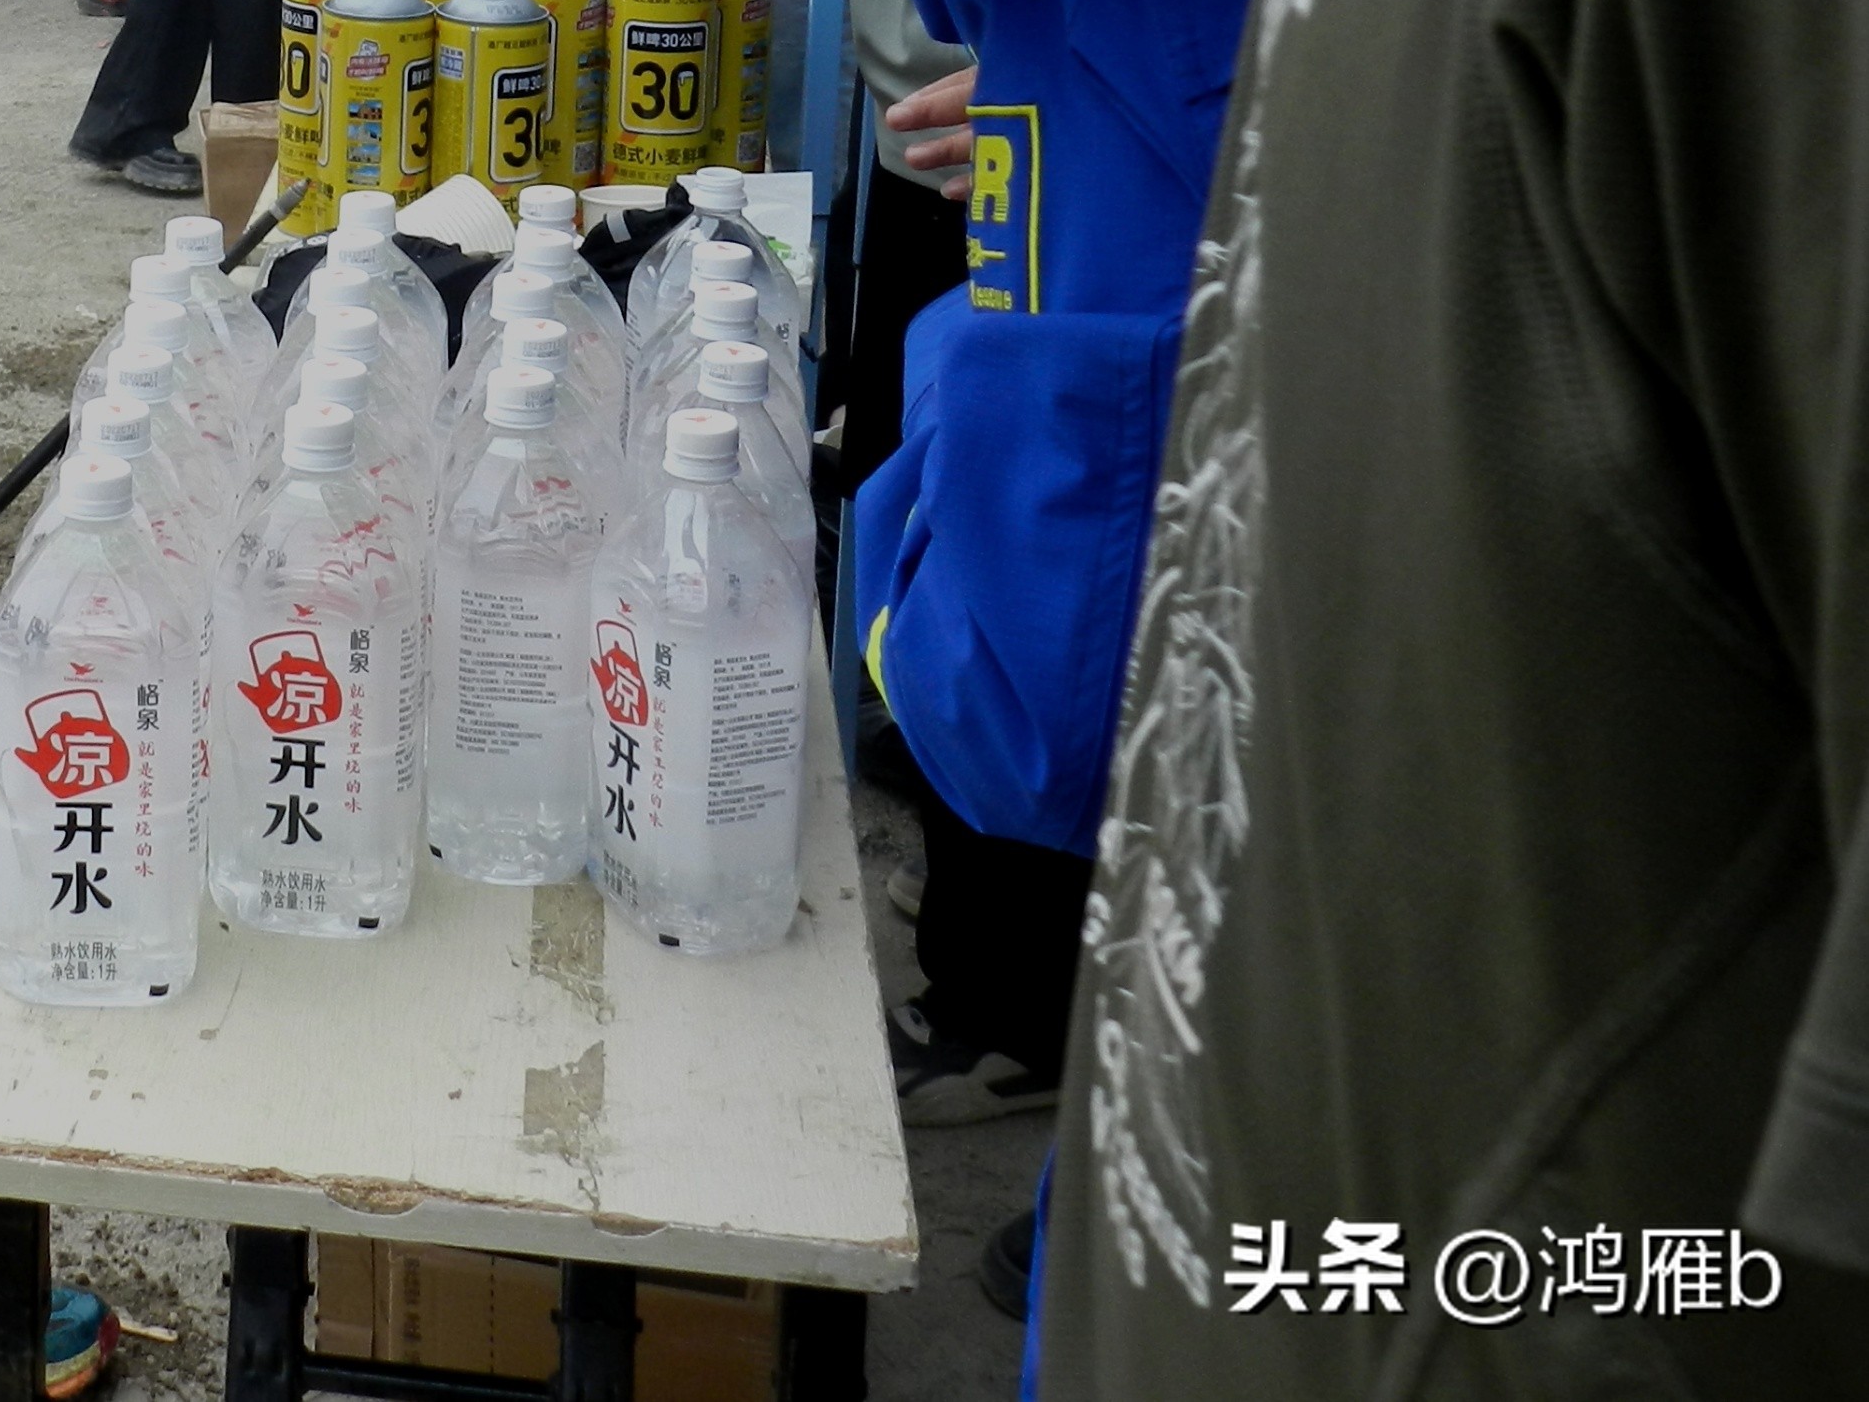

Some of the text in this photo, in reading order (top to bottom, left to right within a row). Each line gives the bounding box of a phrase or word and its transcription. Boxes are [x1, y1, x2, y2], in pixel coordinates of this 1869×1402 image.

[631, 30, 704, 48] 鲜啤30公里
[631, 61, 701, 121] 30
[134, 740, 156, 878] 就是家里烧的味
[262, 671, 329, 845] 凉开水
[344, 683, 365, 814] 就是家里烧的味
[603, 655, 642, 842] 凉开水
[48, 730, 115, 914] 凉开水
